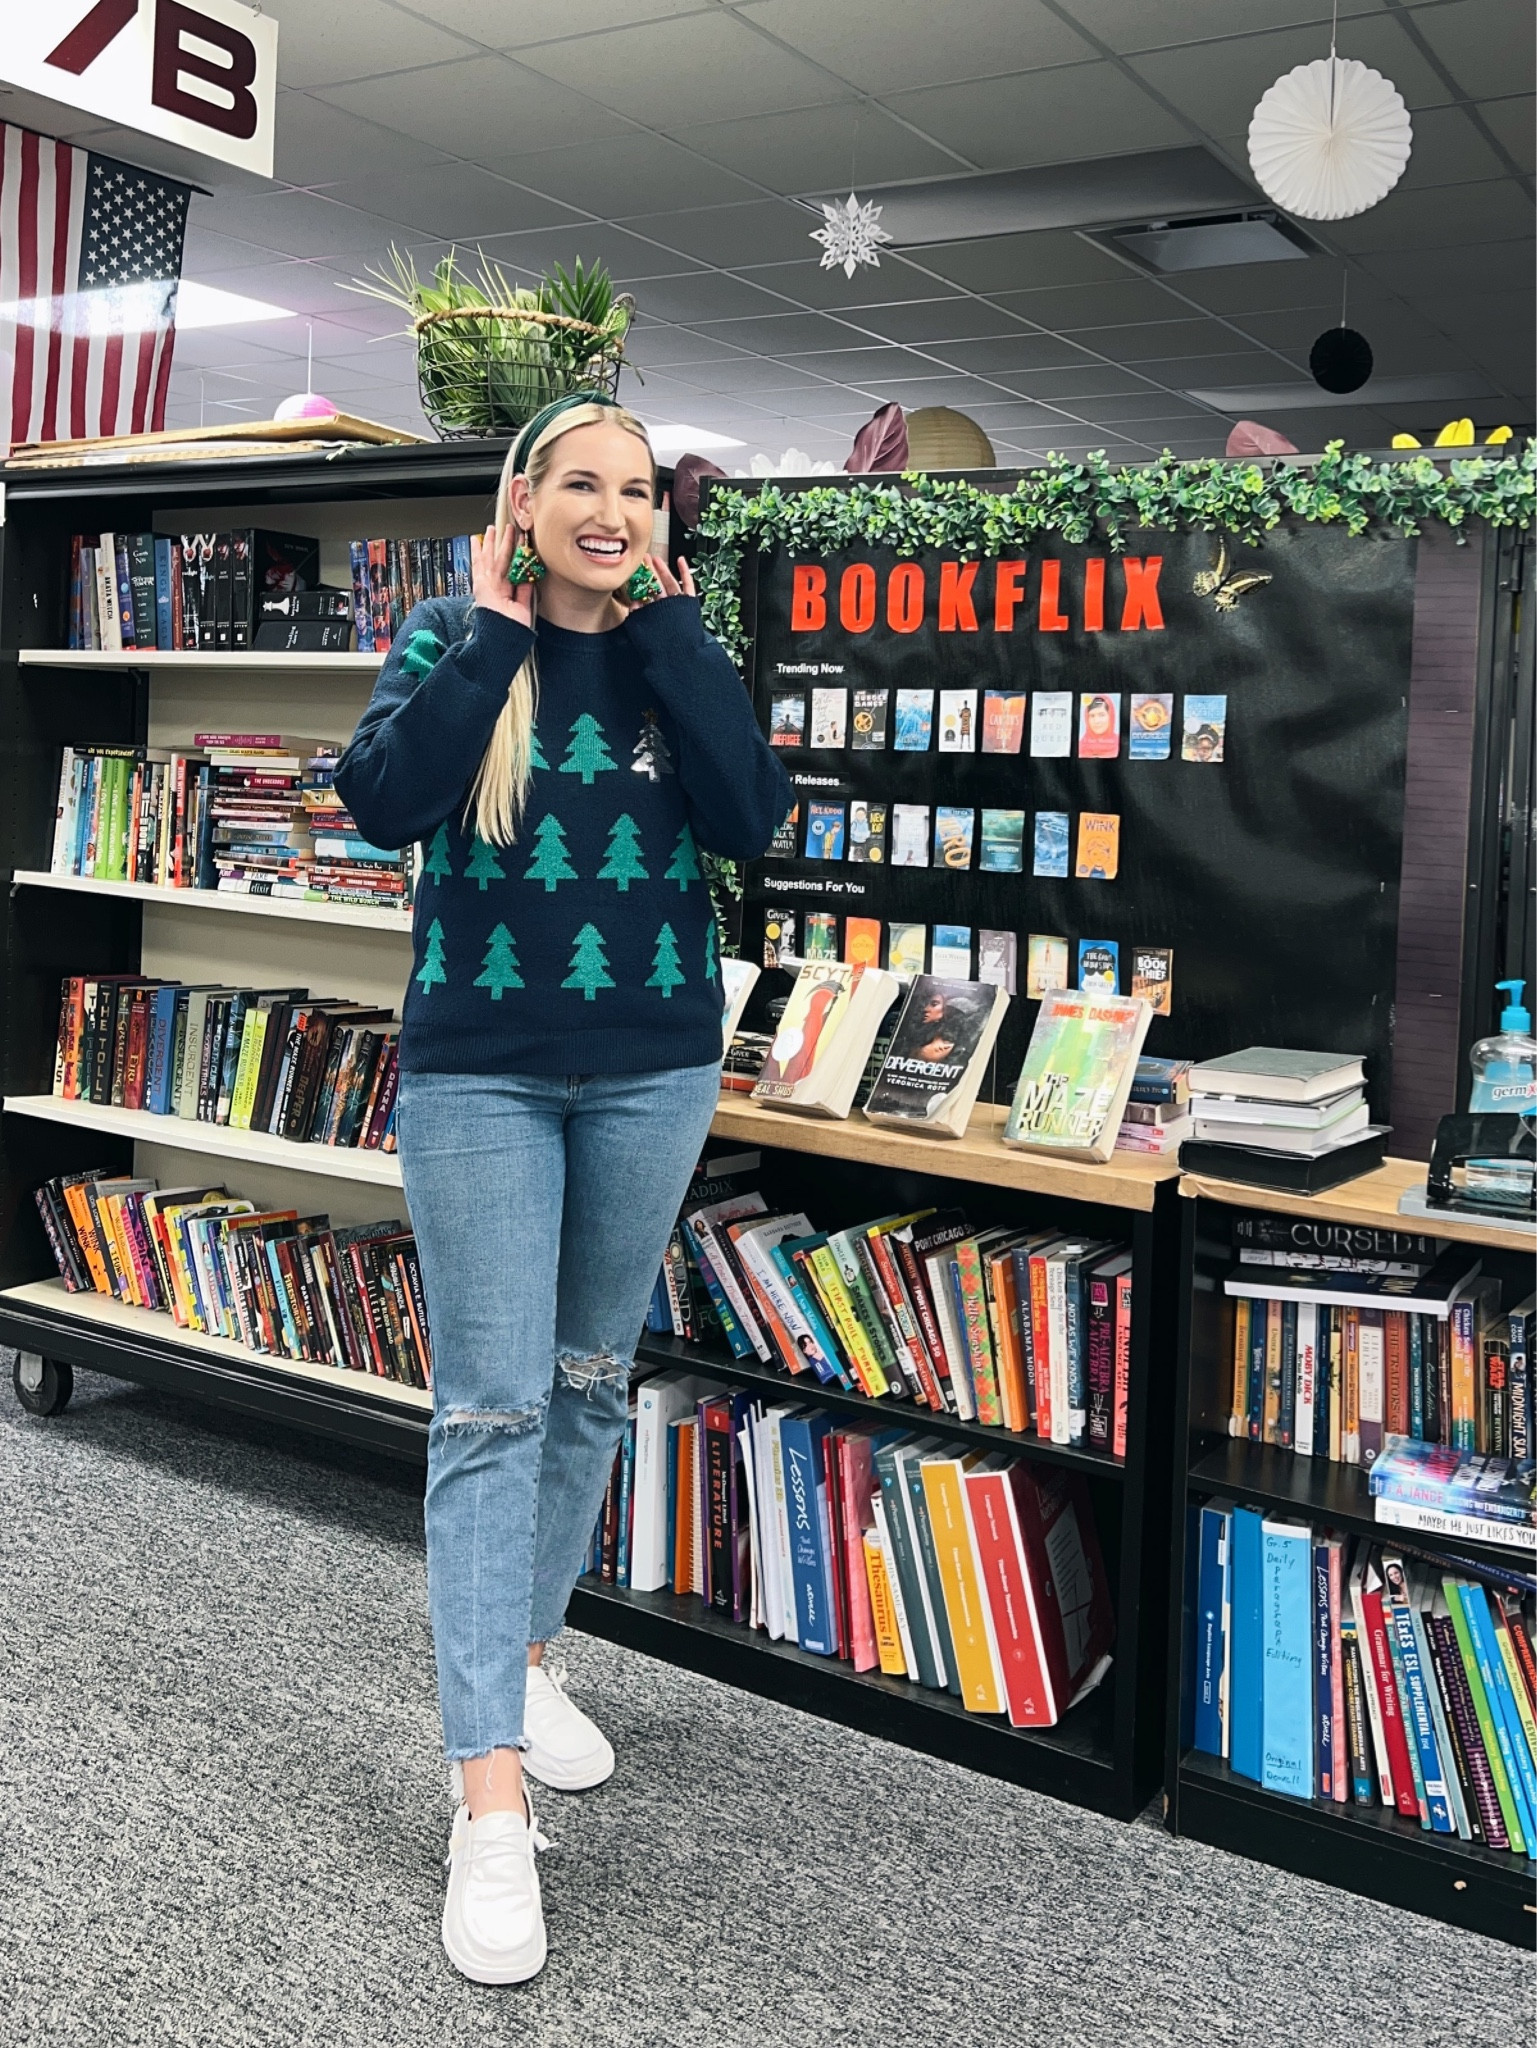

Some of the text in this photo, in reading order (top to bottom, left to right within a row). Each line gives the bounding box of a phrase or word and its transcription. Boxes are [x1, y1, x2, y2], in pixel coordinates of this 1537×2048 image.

[791, 556, 1165, 633] BOOKFLIX
[776, 663, 844, 675] Trending Now
[794, 775, 840, 786] Releases
[869, 811, 885, 823] NEW
[871, 822, 883, 833] KID
[1084, 818, 1116, 832] WINK
[250, 882, 269, 895] elixir
[764, 877, 865, 893] Suggestions For You
[766, 908, 789, 920] GIVER
[806, 948, 837, 960] MAZE
[1137, 956, 1167, 969] BOOK
[1139, 968, 1167, 979] THIEF
[94, 992, 111, 1093] THE TOLL
[114, 1021, 128, 1088] GRACELING
[155, 1019, 165, 1095] DIVERGENT
[185, 1023, 198, 1097] INSURGENT
[128, 1053, 137, 1084] FIRE
[174, 1030, 186, 1101] INSURGENT
[209, 1035, 221, 1089] DEATH CURE
[285, 1033, 302, 1093] THE MAZE RUNNER
[885, 1056, 963, 1079] DIVERGENT
[1044, 1072, 1069, 1085] THE
[199, 1068, 209, 1096] TRIALS
[291, 1074, 309, 1118] DEEPER
[380, 1072, 396, 1113] DRAMA
[887, 1078, 924, 1089] VERONICA
[927, 1083, 947, 1091] ROTH
[1020, 1081, 1115, 1118] MAZE
[1016, 1111, 1104, 1137] RUNNER
[87, 1195, 102, 1228] LOIS LOWRY
[76, 1225, 92, 1251] WINK
[87, 1229, 103, 1253] WINK
[136, 1231, 149, 1267] SPIN
[144, 1226, 157, 1248] ELEVEN
[914, 1228, 964, 1252] PORT CHICAGO
[1290, 1222, 1413, 1256] CURSED
[407, 1262, 422, 1293] OCTAVIA
[415, 1302, 427, 1327] BUTLER
[1055, 1267, 1064, 1290] Chicken
[284, 1272, 301, 1327] FIRESTORM!
[301, 1285, 314, 1327] DARKNESS
[367, 1281, 382, 1330] ILLEGAL
[762, 1277, 773, 1289] AM
[770, 1290, 786, 1312] HERE
[782, 1310, 801, 1334] NOW
[379, 1296, 395, 1345] ON BLOOD ROAD
[717, 1304, 736, 1332] TREE
[832, 1284, 872, 1374] FIRST RULE PUNK
[851, 1286, 886, 1362] SNAKES STONES
[915, 1290, 941, 1358] PORT CHICAGO 50
[1453, 1309, 1462, 1352] Teenage Soul
[1461, 1309, 1471, 1335] Chicken
[971, 1326, 986, 1374] Sunshine
[1021, 1299, 1035, 1385] ALABAMA MOON
[1067, 1303, 1078, 1407] NOT AS WE KNOW IT
[1089, 1328, 1099, 1384] ALGEBRA
[1390, 1326, 1400, 1350] THE
[1461, 1336, 1471, 1354] Soup
[909, 1343, 932, 1394] Jay McGraw
[1100, 1321, 1110, 1393] PRE-ALGEBRA
[1303, 1344, 1315, 1405] MOBY DICK
[1463, 1355, 1471, 1366] for
[1489, 1356, 1500, 1389] WARS
[1511, 1382, 1526, 1459] MIDNIGHT SUN
[709, 1441, 725, 1550] LITERATURE
[789, 1447, 811, 1531] Lessons
[1283, 1540, 1291, 1549] 5
[1418, 1514, 1537, 1545] MAYBE HE JUST LIKES YOU
[1267, 1552, 1295, 1568] Daily
[870, 1551, 887, 1633] Thesaurus
[887, 1557, 906, 1630] THIS SAME SKY
[1316, 1565, 1328, 1607] Lessons
[1205, 1642, 1213, 1667] Language
[1373, 1629, 1395, 1717] Grammar for Writing
[1396, 1613, 1429, 1737] TExES ESL SUPPLEMENTAL
[1354, 1697, 1363, 1721] ENGLISH
[1392, 1656, 1421, 1783] THE WRITING TEACHER
[1497, 1726, 1512, 1756] Spelling
[1513, 1733, 1529, 1770] Vocabulary
[1266, 1751, 1301, 1768] Original
